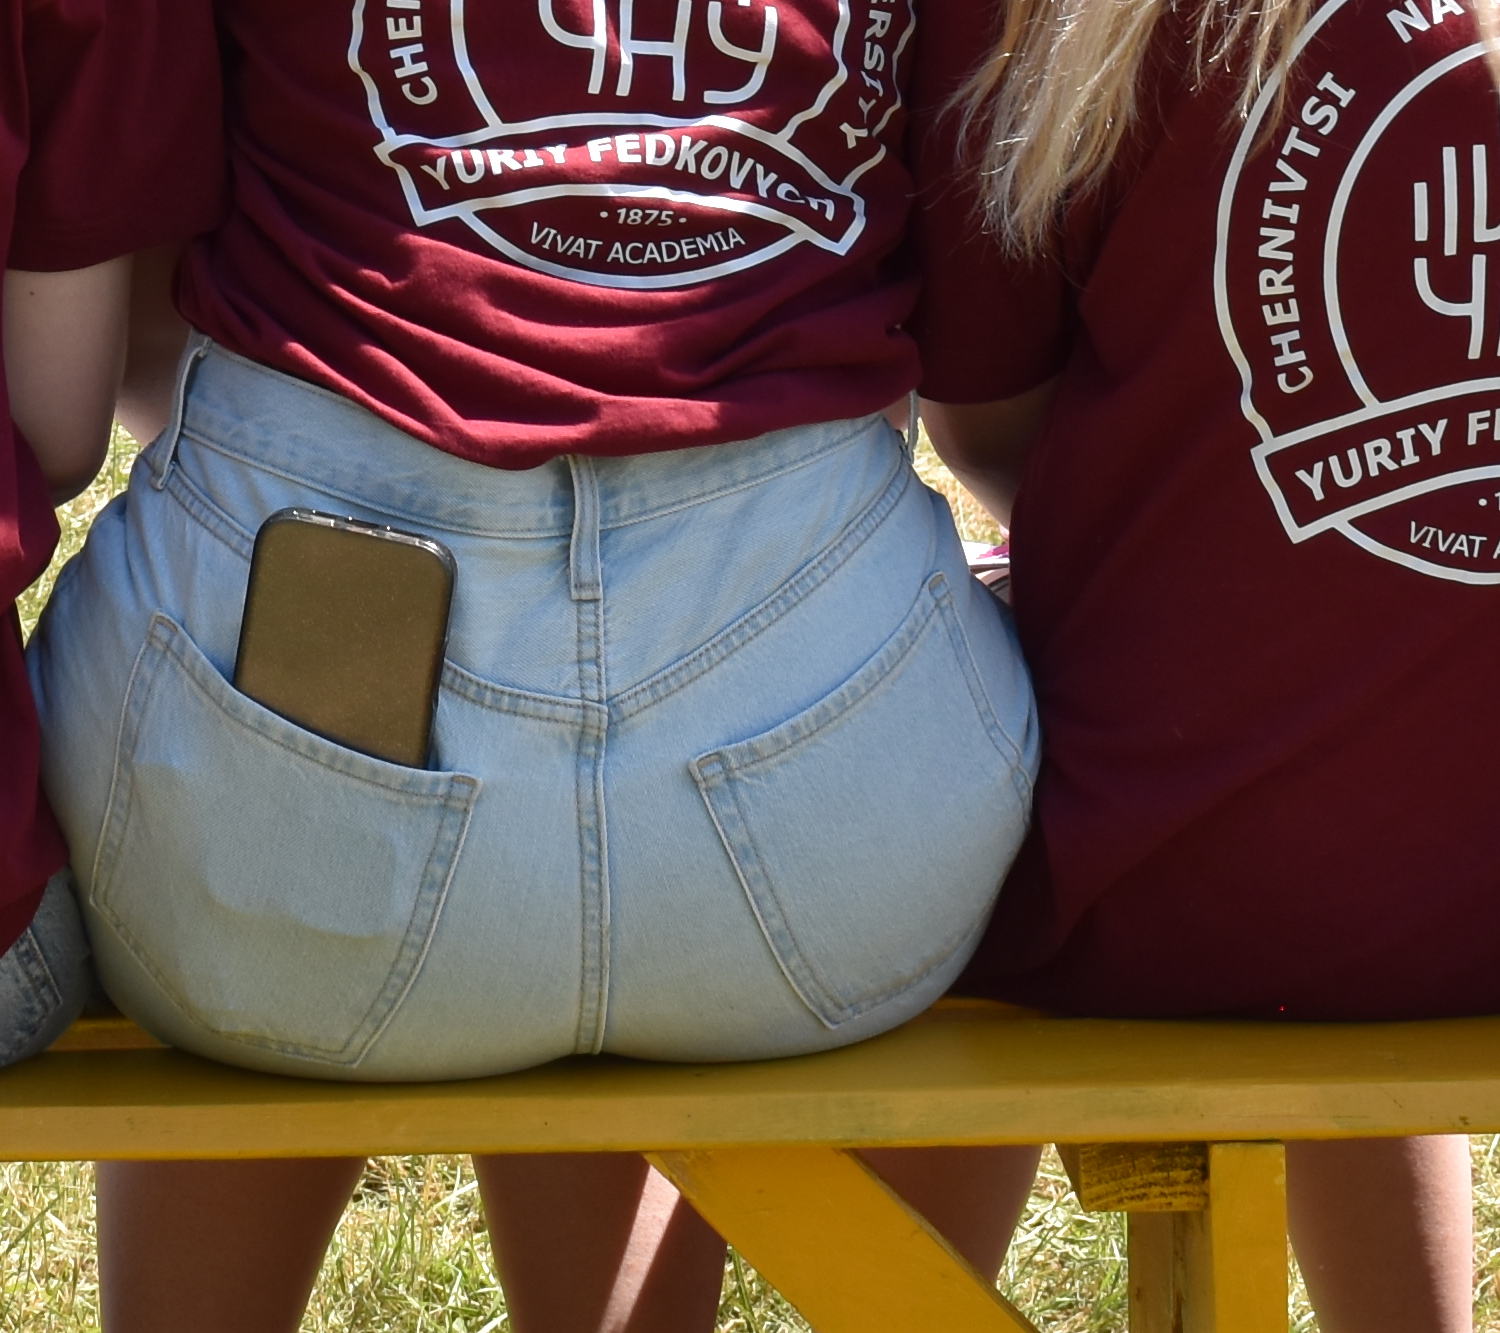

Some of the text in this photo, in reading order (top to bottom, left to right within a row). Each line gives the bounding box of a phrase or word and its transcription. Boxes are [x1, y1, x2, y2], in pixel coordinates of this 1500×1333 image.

[420, 142, 569, 192] YURIY
[617, 206, 674, 227] 1875
[1257, 72, 1357, 396] CHERNIVTSI
[530, 222, 746, 265] VIVAT ACADEMIA
[1294, 418, 1450, 502] YURIY
[1408, 520, 1488, 560] VIVAT
